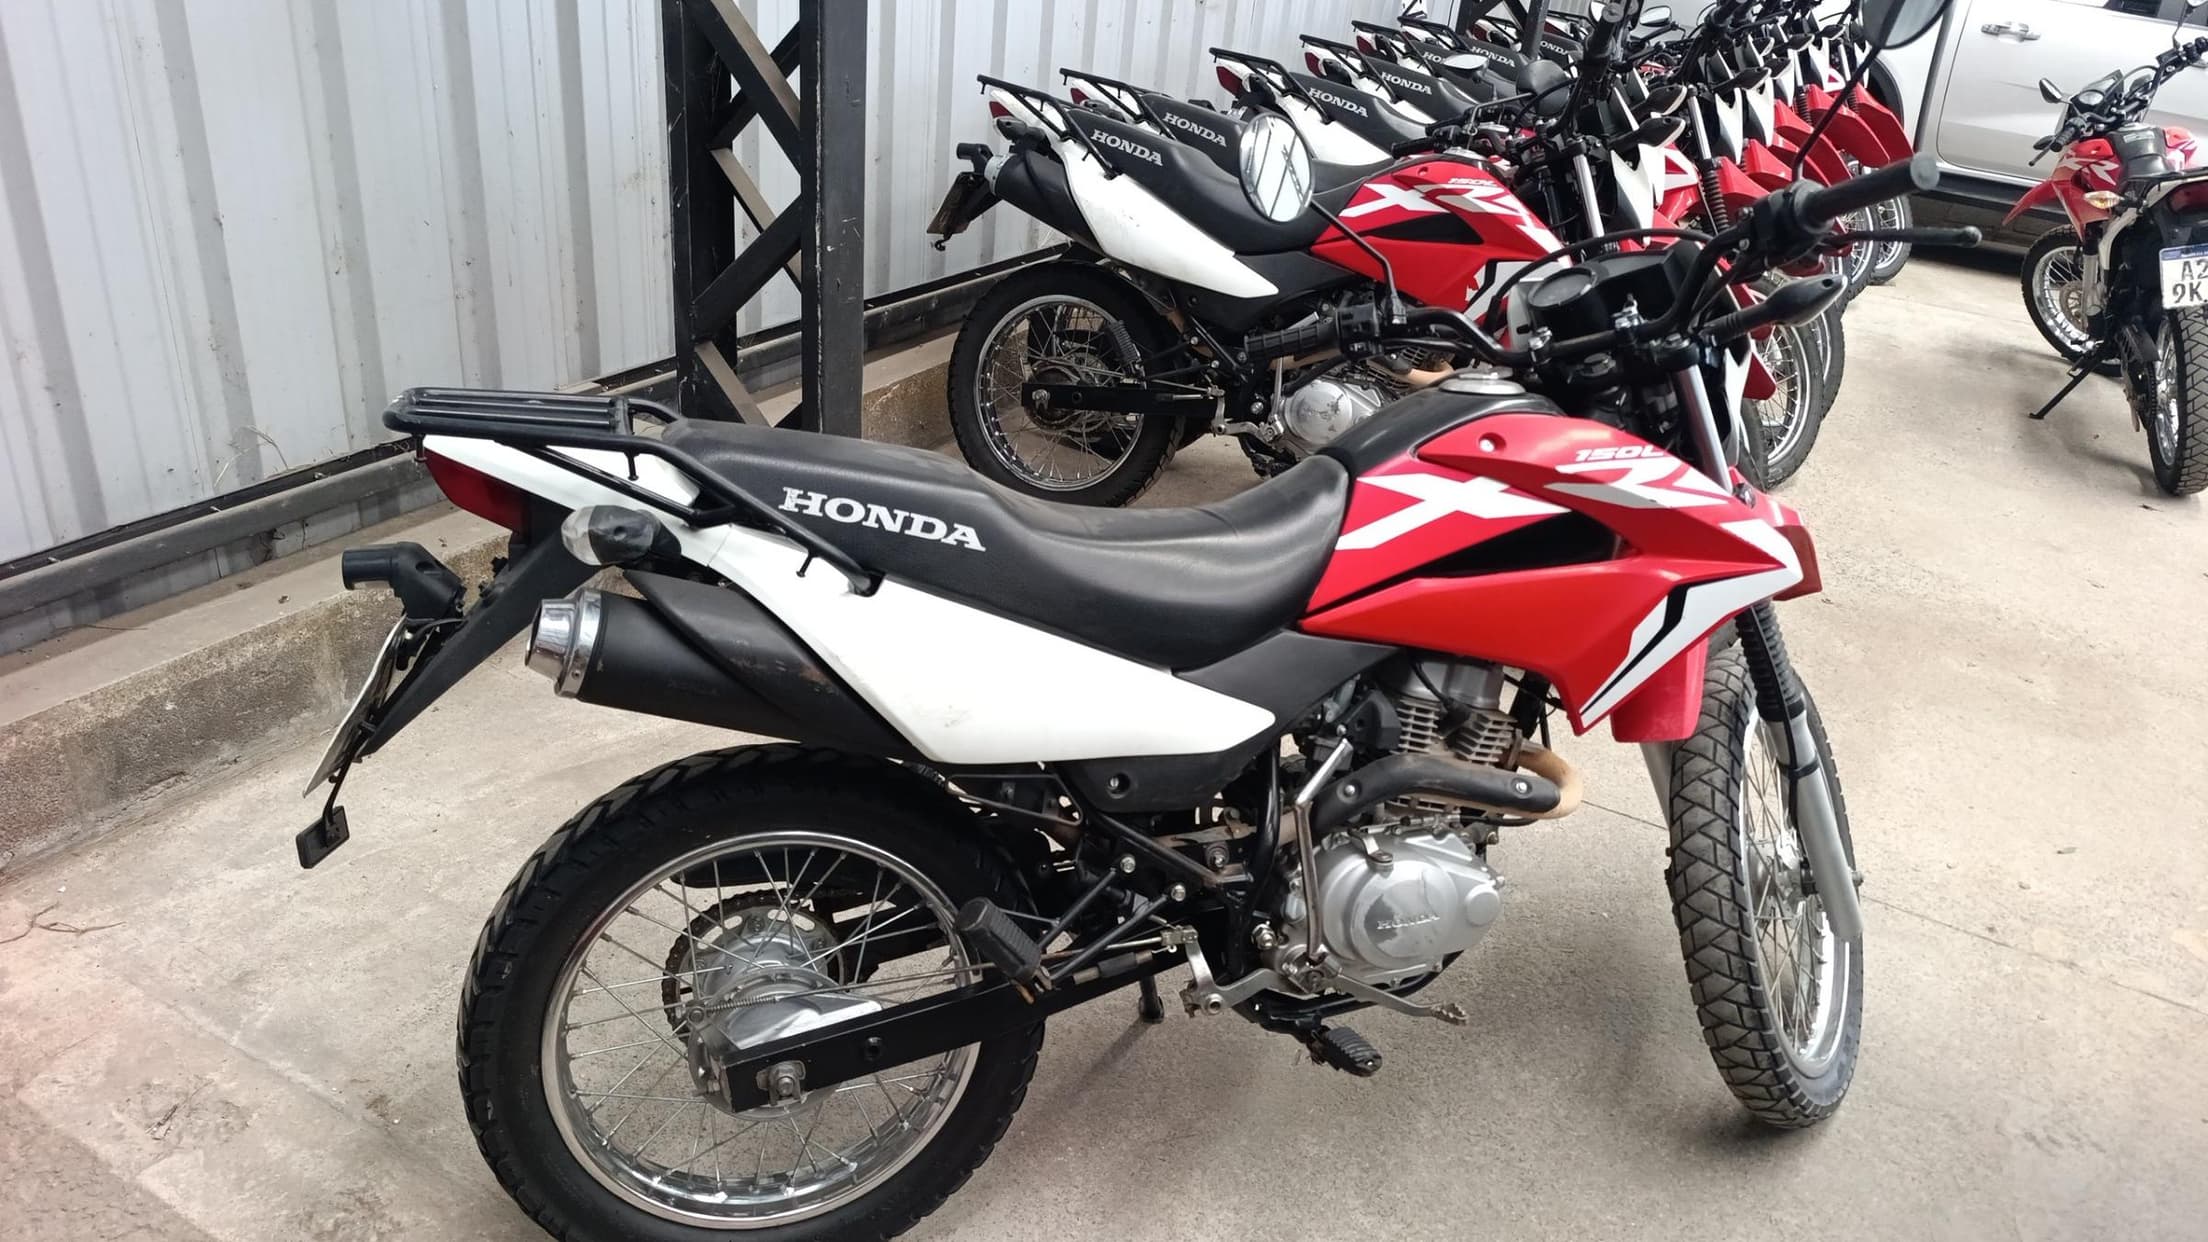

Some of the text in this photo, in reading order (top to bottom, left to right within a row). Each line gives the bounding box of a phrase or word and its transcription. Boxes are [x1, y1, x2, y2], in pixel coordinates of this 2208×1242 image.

[1471, 46, 1515, 67] HONDA
[1540, 40, 1569, 55] ONDA
[1381, 71, 1433, 95] HONDA
[1308, 87, 1369, 118] HONDA
[1163, 111, 1228, 147] HONDA
[1090, 129, 1164, 167] HONDA
[2181, 260, 2208, 281] A2
[2172, 281, 2203, 304] 9K
[1576, 444, 1665, 462] 150L
[779, 486, 987, 551] HONDA
